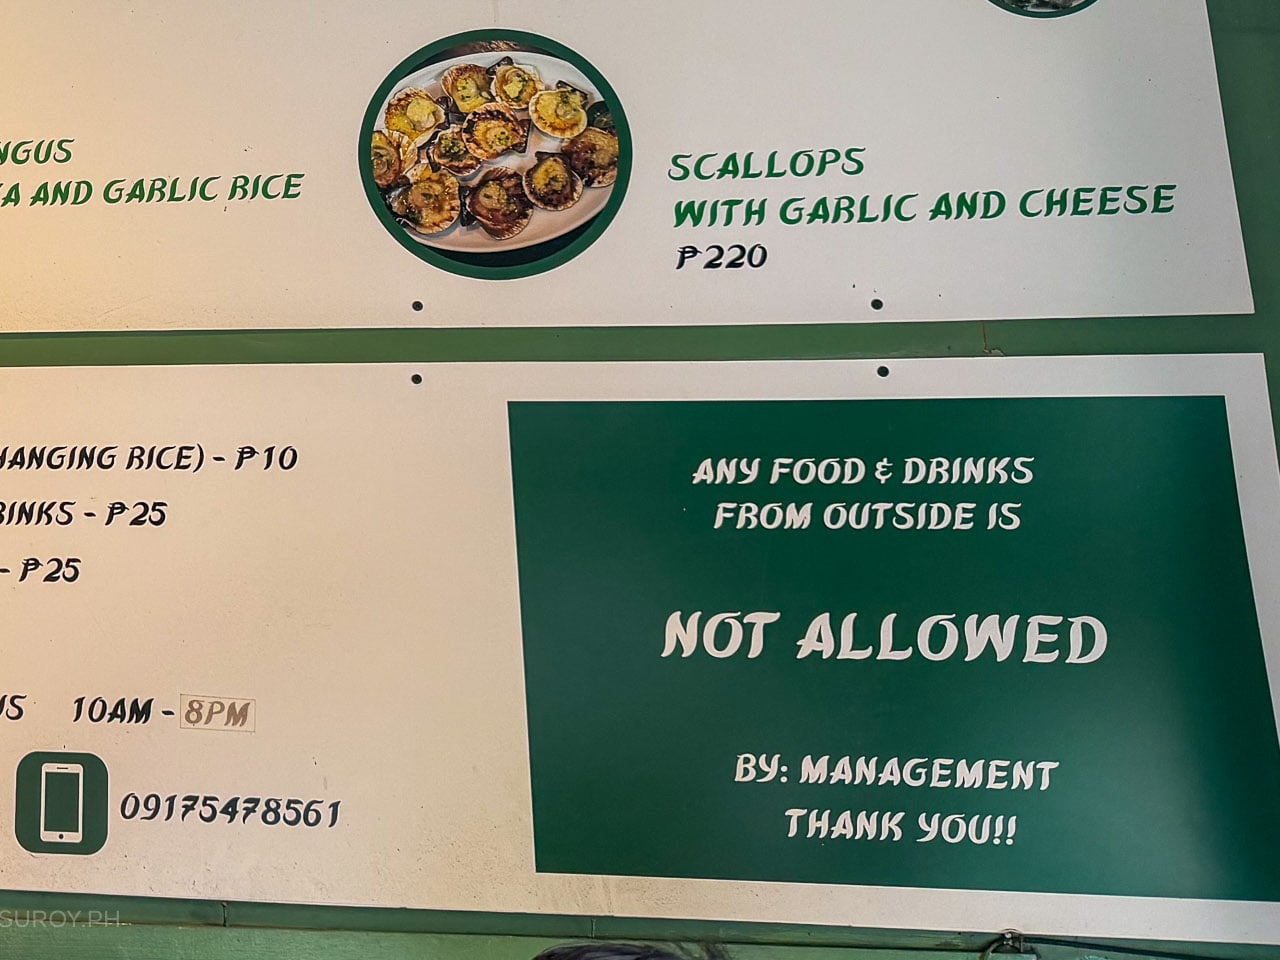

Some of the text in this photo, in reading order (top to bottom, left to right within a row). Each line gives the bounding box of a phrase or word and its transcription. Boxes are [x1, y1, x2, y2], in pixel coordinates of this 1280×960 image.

[667, 147, 866, 181] SCALLOPS
[29, 180, 93, 207] AND
[102, 175, 222, 204] GARLIC
[227, 173, 305, 201] RICE
[673, 184, 1177, 228] WITH GARLIC AND CHEESE
[125, 443, 205, 473] RICE)
[692, 456, 1035, 485] ANY FOOD & DRINKS
[713, 502, 1022, 530] FROM OUTSIDE IS
[660, 610, 1108, 664] NOT ALLOWED
[73, 696, 154, 725] 10AM
[184, 699, 251, 728] 8PM
[734, 753, 1060, 791] BY: MANAGEMENT
[120, 792, 341, 828] 09175478561
[784, 808, 1017, 846] THANK YOU!!
